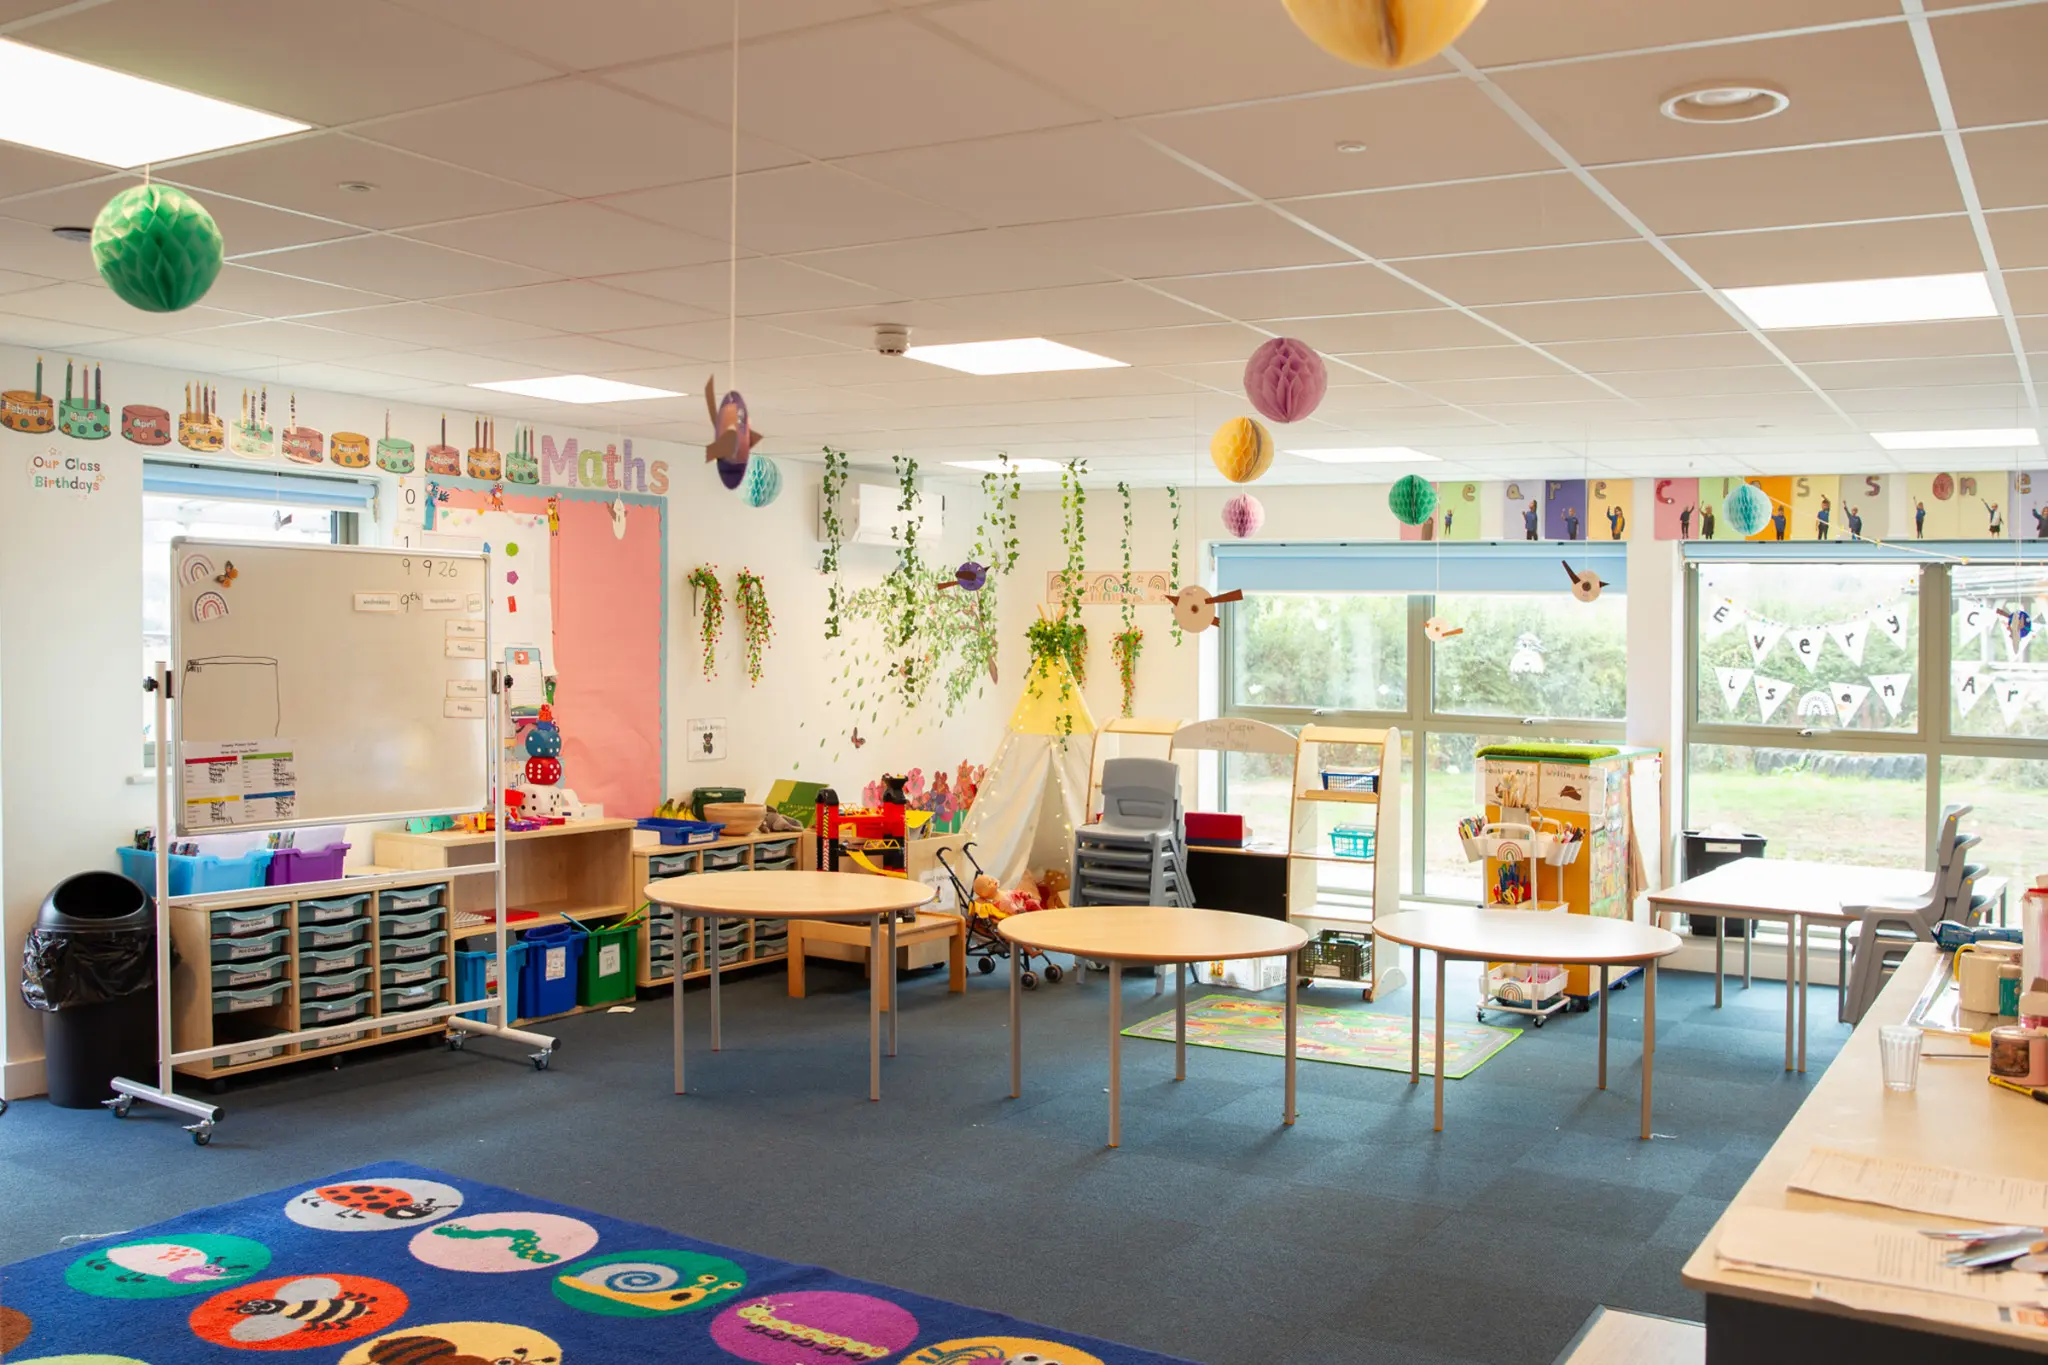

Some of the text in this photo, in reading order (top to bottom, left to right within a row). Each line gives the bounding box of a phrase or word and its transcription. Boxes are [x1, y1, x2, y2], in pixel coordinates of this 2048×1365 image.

[6, 403, 48, 417] February
[33, 456, 101, 472] Our Class
[541, 434, 669, 494] Maths
[34, 475, 100, 494] Birthdays
[402, 558, 411, 576] 9
[423, 559, 432, 577] 9
[400, 592, 421, 614] 9th
